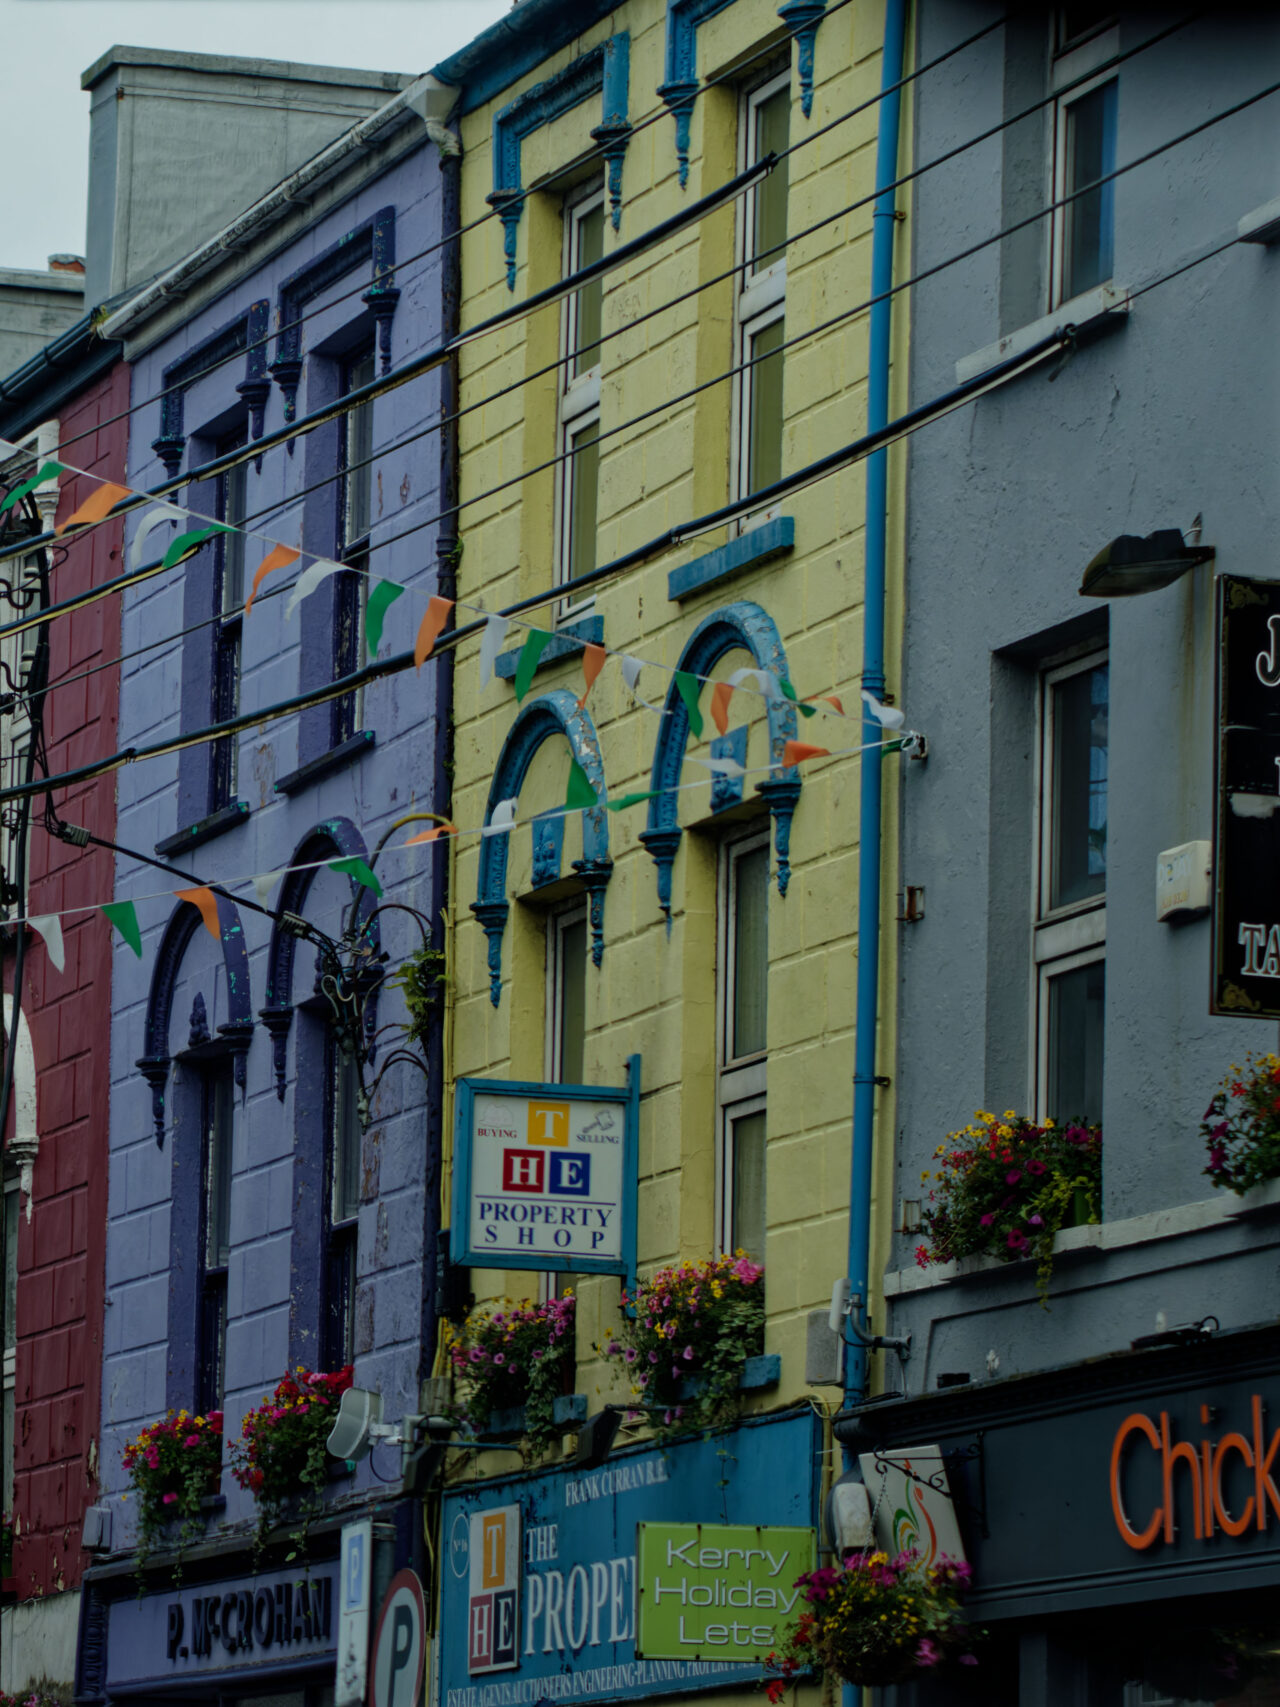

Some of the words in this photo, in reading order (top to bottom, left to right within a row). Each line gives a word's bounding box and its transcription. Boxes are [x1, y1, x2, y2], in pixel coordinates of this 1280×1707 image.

[477, 1127, 517, 1139] BUYING
[576, 1134, 620, 1145] SELLING
[479, 1202, 613, 1228] PROPERTY
[484, 1225, 605, 1250] SHOP
[565, 1474, 600, 1507] FRANK
[526, 1523, 559, 1563] THE
[667, 1538, 790, 1576] Kerry
[524, 1554, 637, 1655] PROPE
[655, 1576, 801, 1614] Holiday
[167, 1604, 188, 1659] P.
[679, 1615, 776, 1646] Lets
[387, 1604, 414, 1707] P
